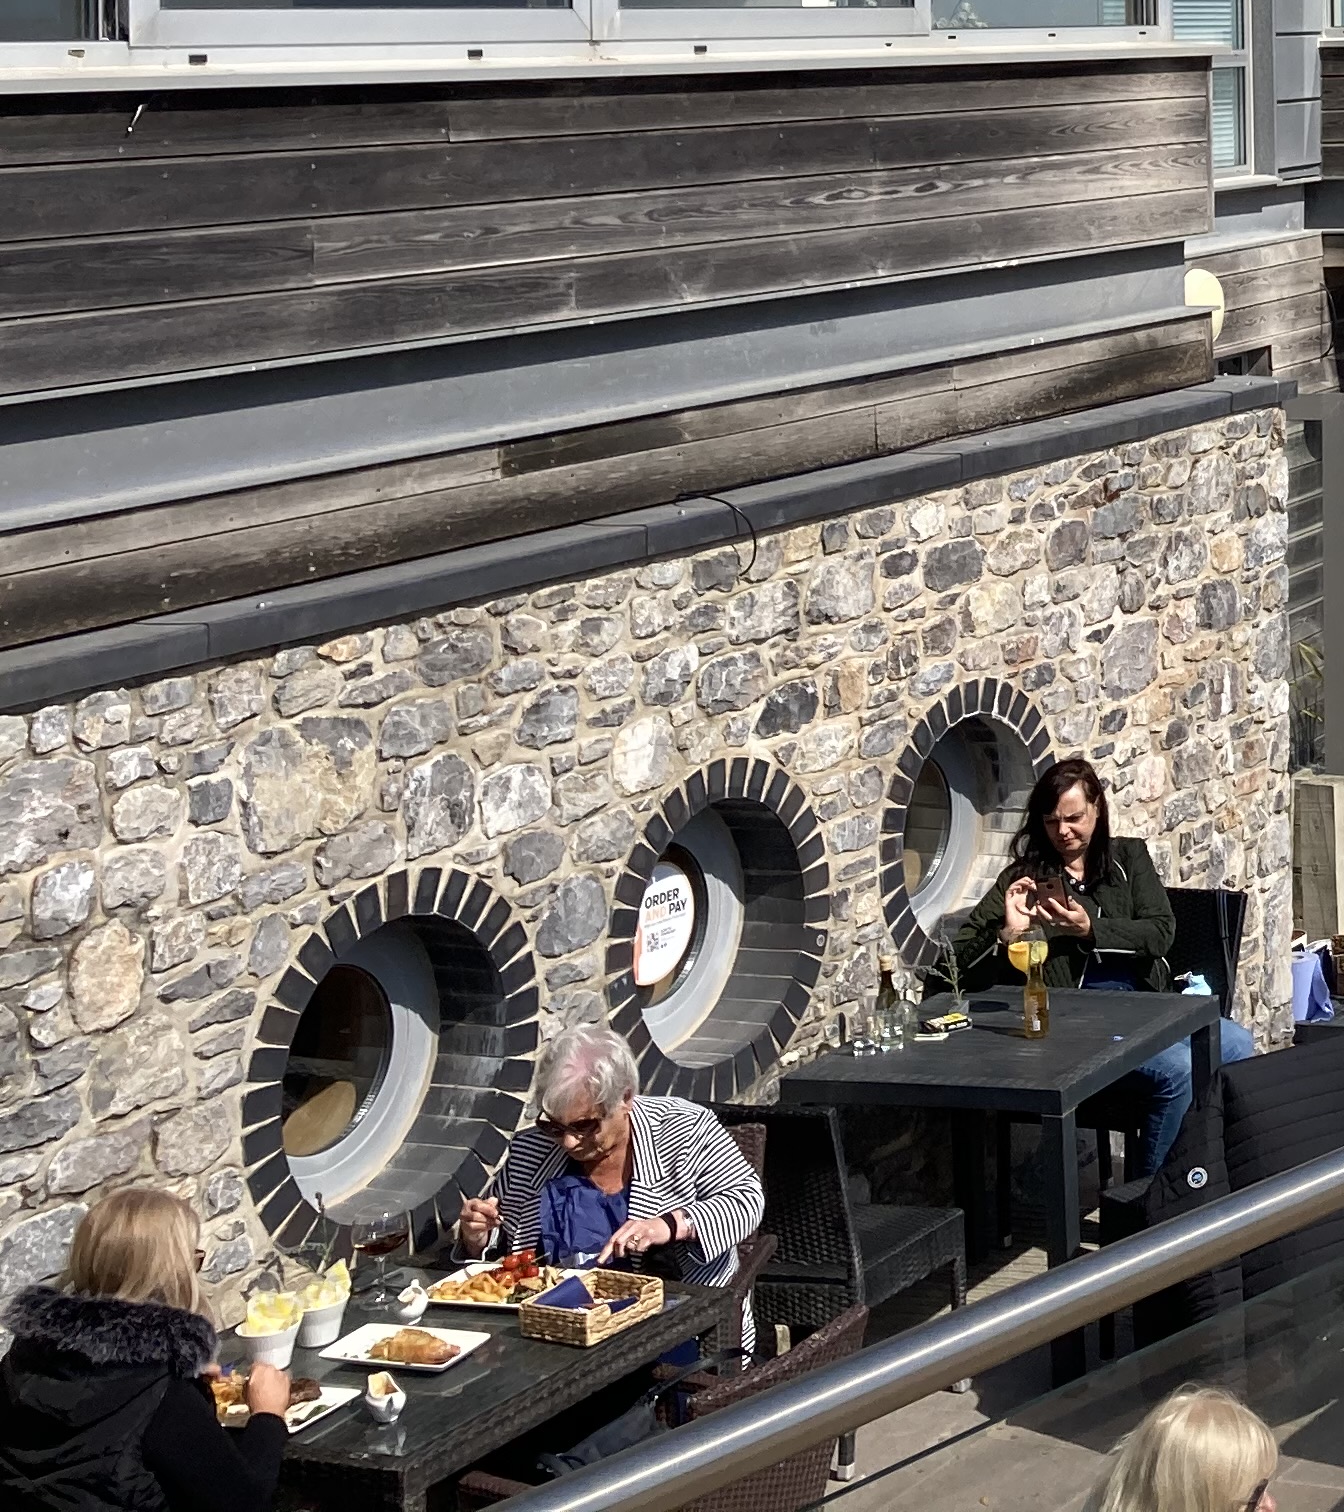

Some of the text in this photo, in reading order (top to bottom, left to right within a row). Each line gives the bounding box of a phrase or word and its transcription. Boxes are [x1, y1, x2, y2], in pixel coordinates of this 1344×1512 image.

[645, 888, 679, 909] ORDER
[645, 906, 666, 922] AND
[669, 898, 687, 915] PAY
